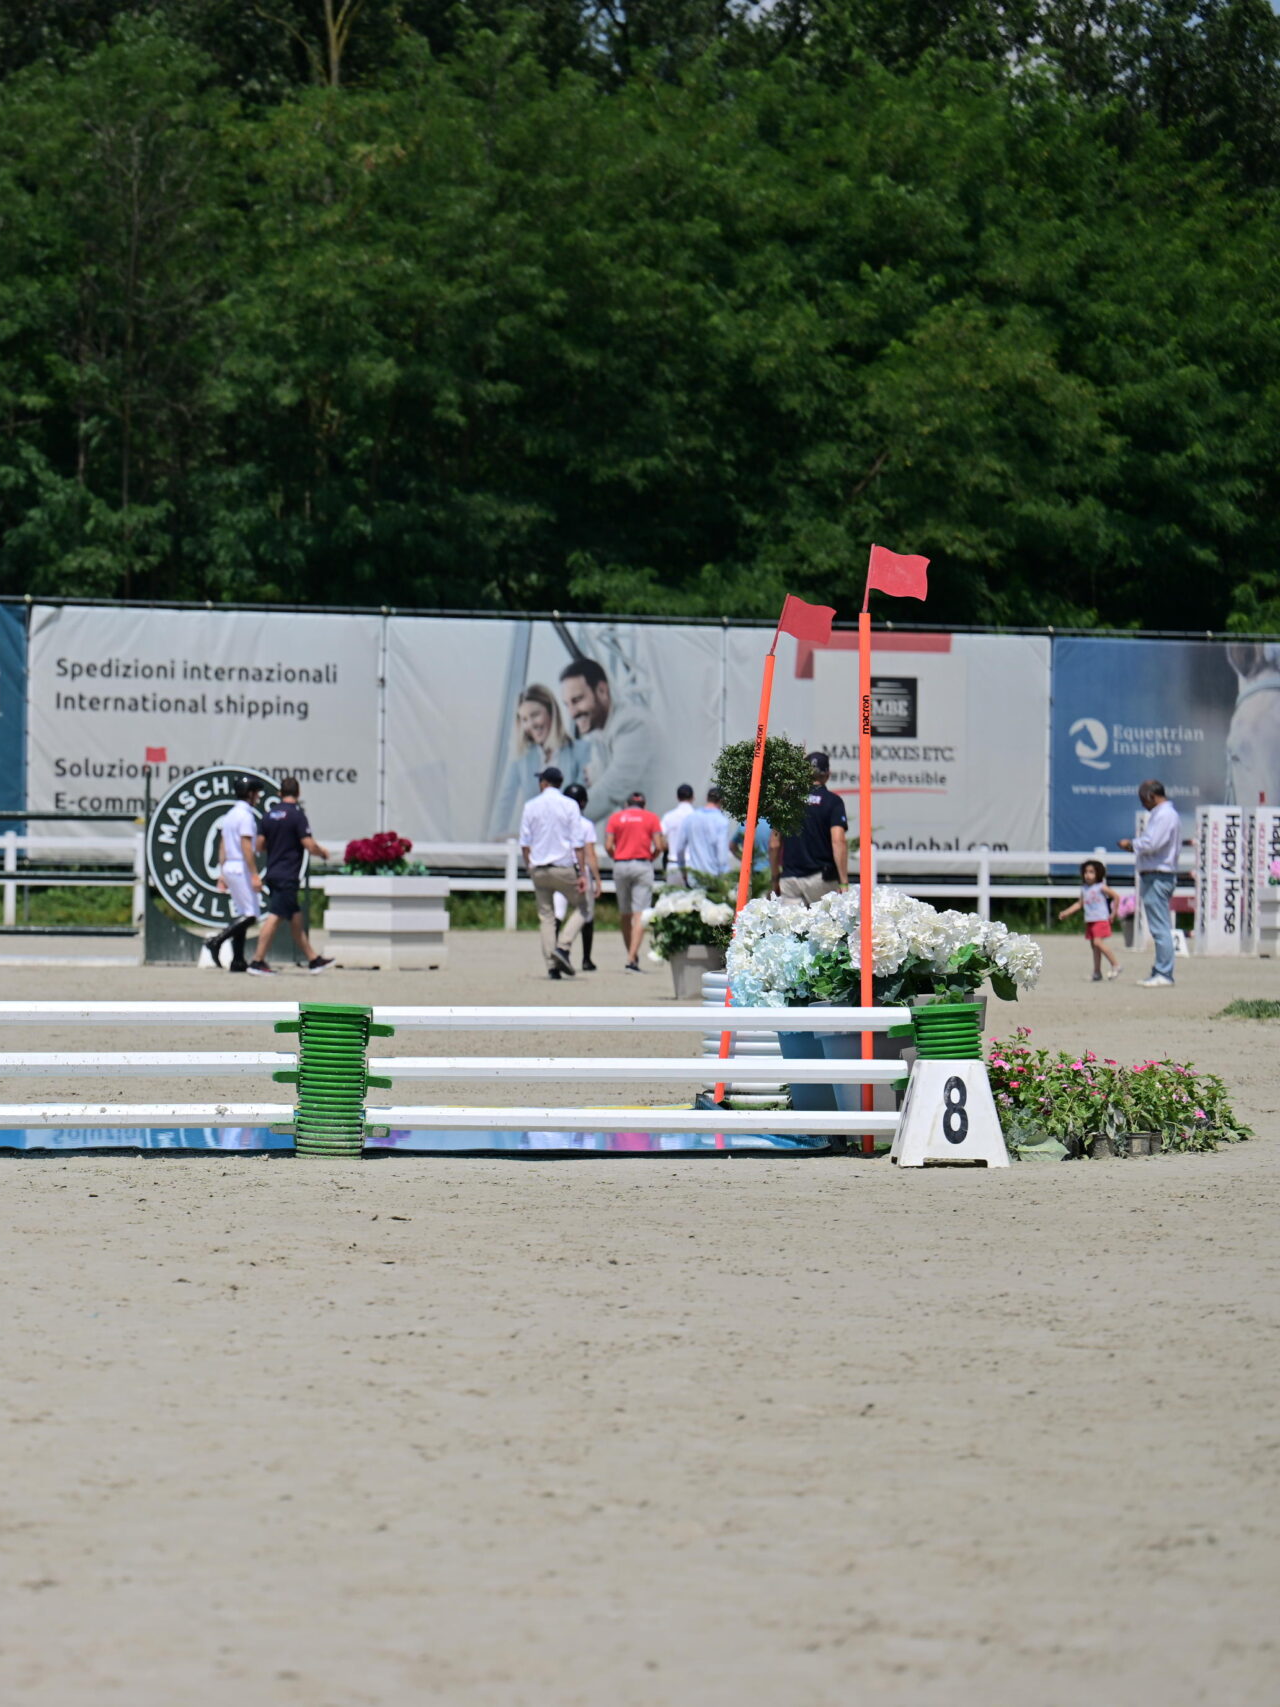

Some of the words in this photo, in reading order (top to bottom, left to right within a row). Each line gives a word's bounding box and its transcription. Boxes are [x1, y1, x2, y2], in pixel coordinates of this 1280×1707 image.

[55, 657, 176, 682] Spedizioni
[182, 660, 338, 684] internazionali
[55, 692, 208, 714] International
[213, 693, 310, 721] shipping
[862, 694, 870, 735] macron
[1112, 724, 1205, 743] Equestrian
[822, 745, 859, 761] MAI
[1112, 740, 1183, 759] Insights
[54, 758, 160, 780] Soluzioni
[830, 770, 948, 786] #PelePossible
[1221, 814, 1240, 874] Happy
[1224, 879, 1239, 934] Horse
[943, 1075, 969, 1145] 8
